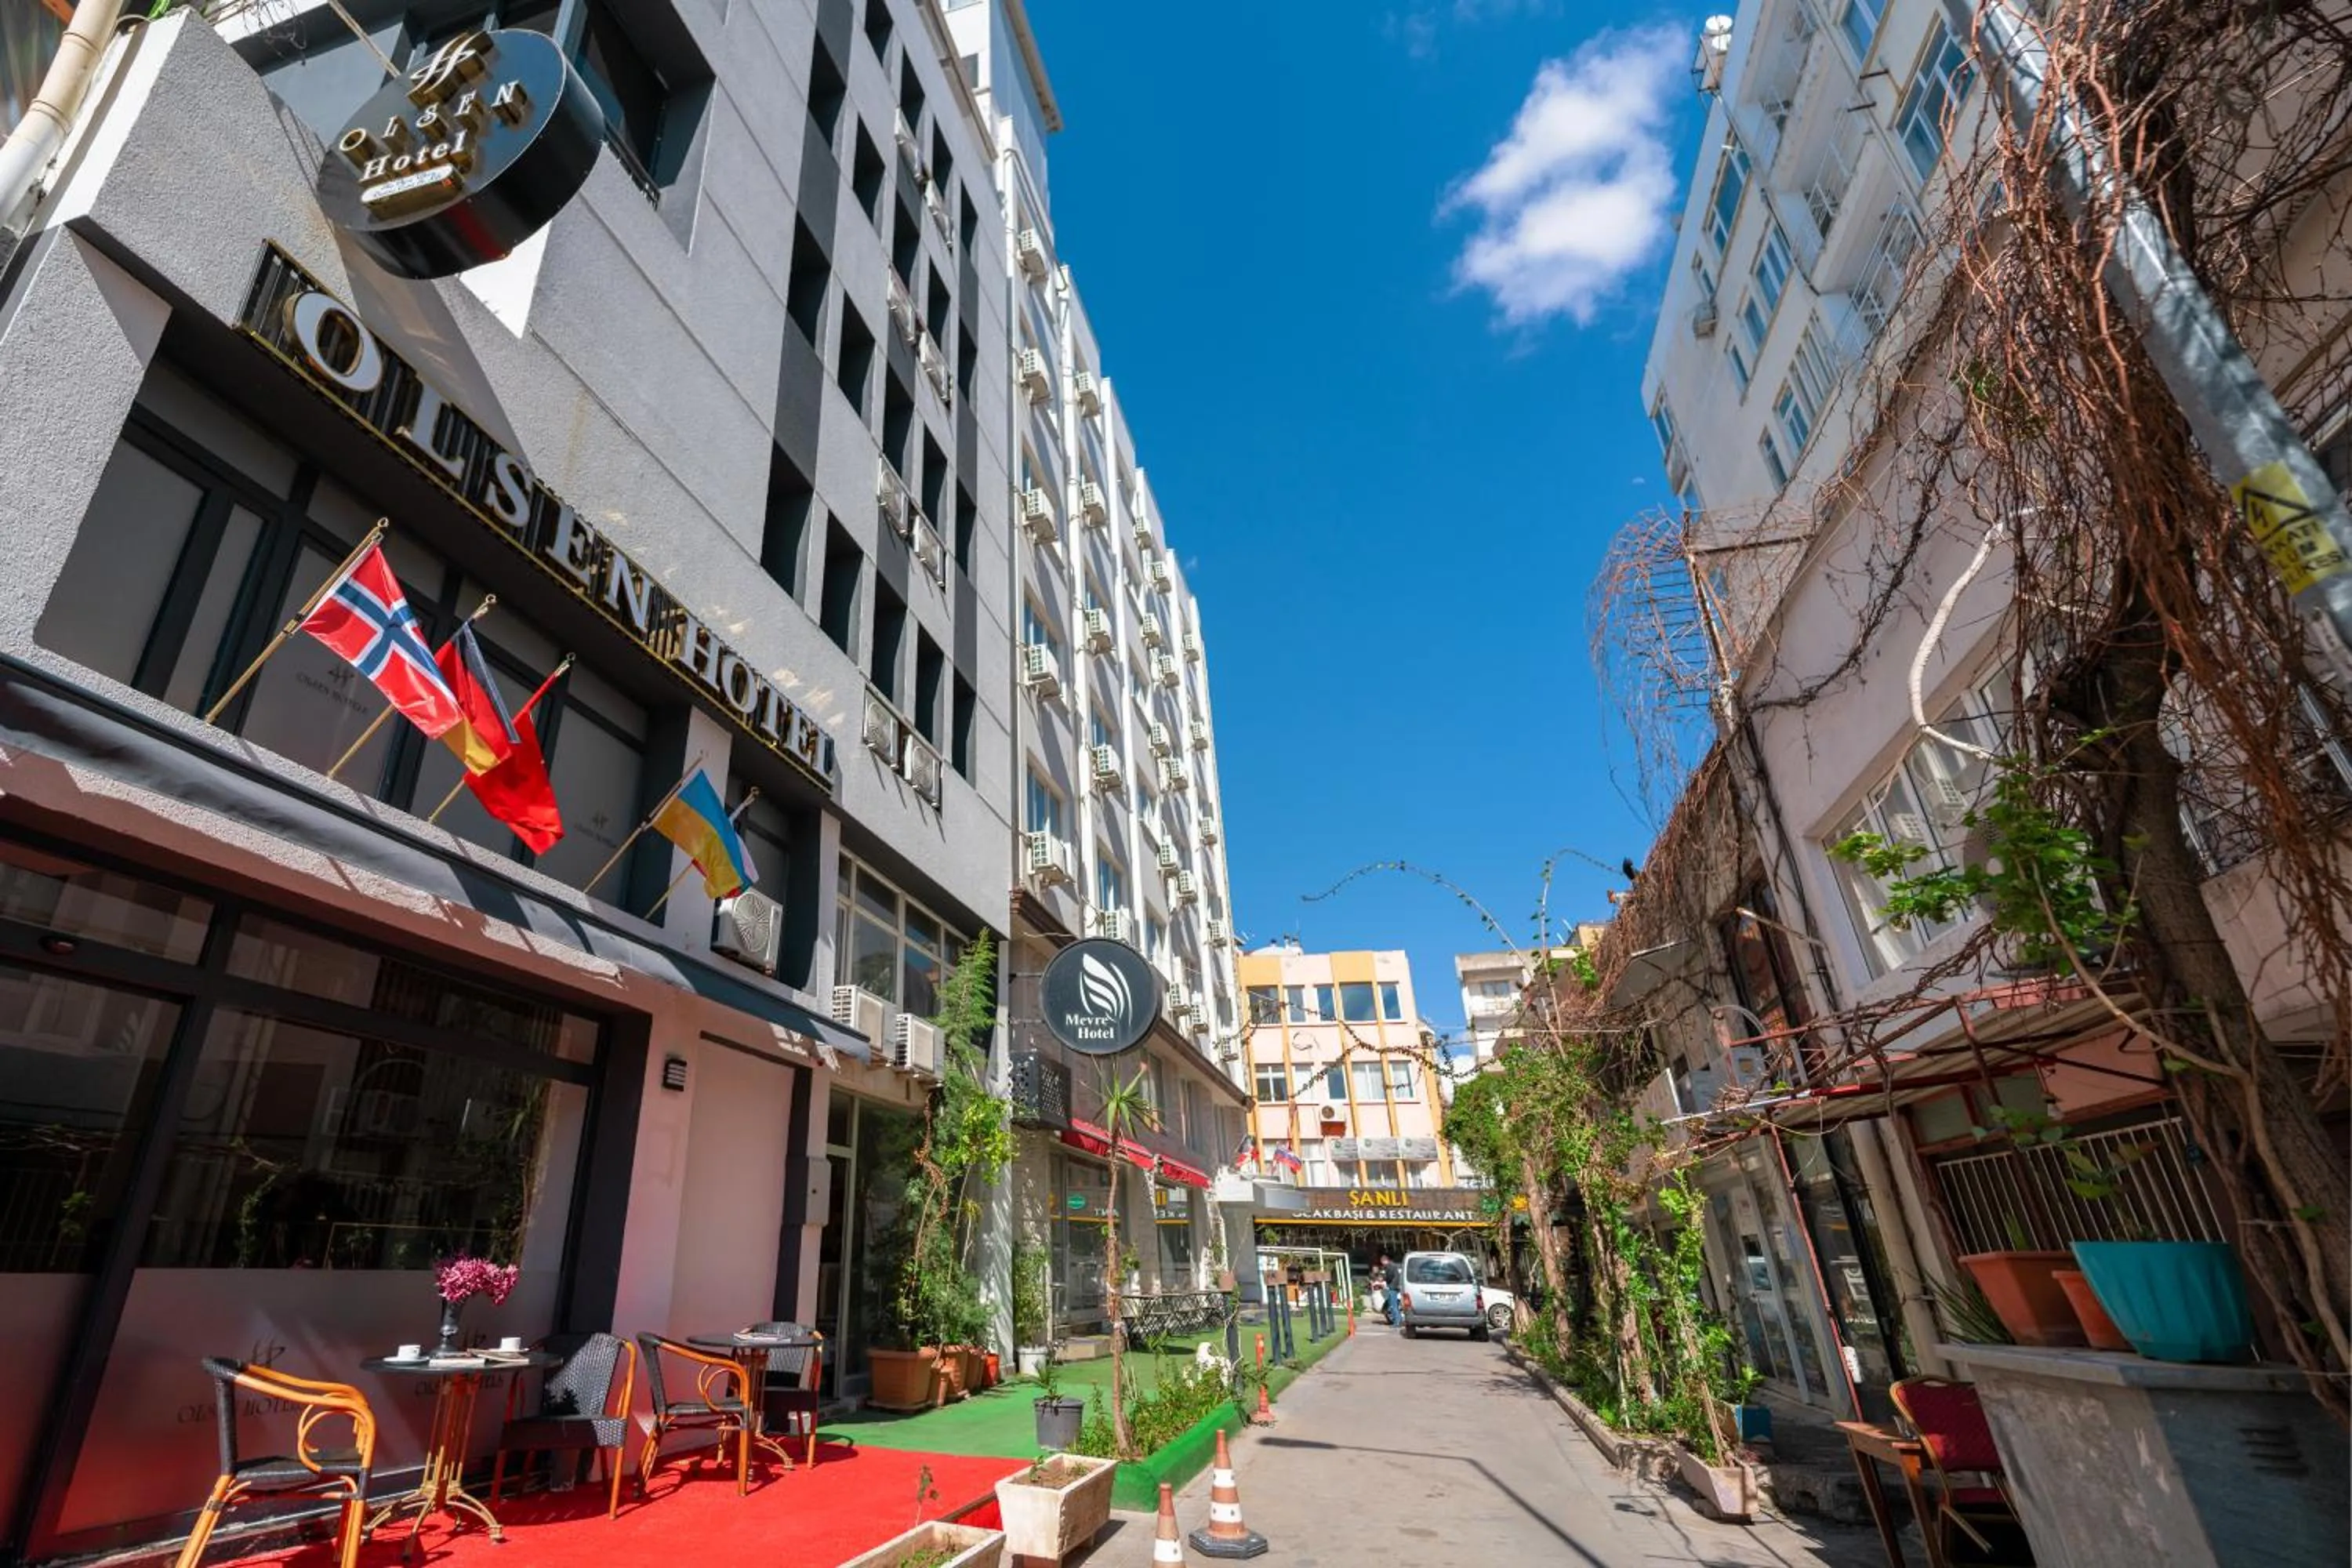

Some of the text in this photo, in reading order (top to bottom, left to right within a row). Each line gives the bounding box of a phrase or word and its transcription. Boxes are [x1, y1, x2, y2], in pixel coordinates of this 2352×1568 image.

[339, 80, 519, 152] OLSEN
[359, 129, 467, 181] Hotel
[284, 291, 835, 782] OLSEN HOTEL
[1065, 1014, 1109, 1026] Mevre
[1078, 1027, 1114, 1039] Hotel
[1349, 1189, 1407, 1207] ŞANLI
[1379, 1210, 1472, 1220] RESTAURANT
